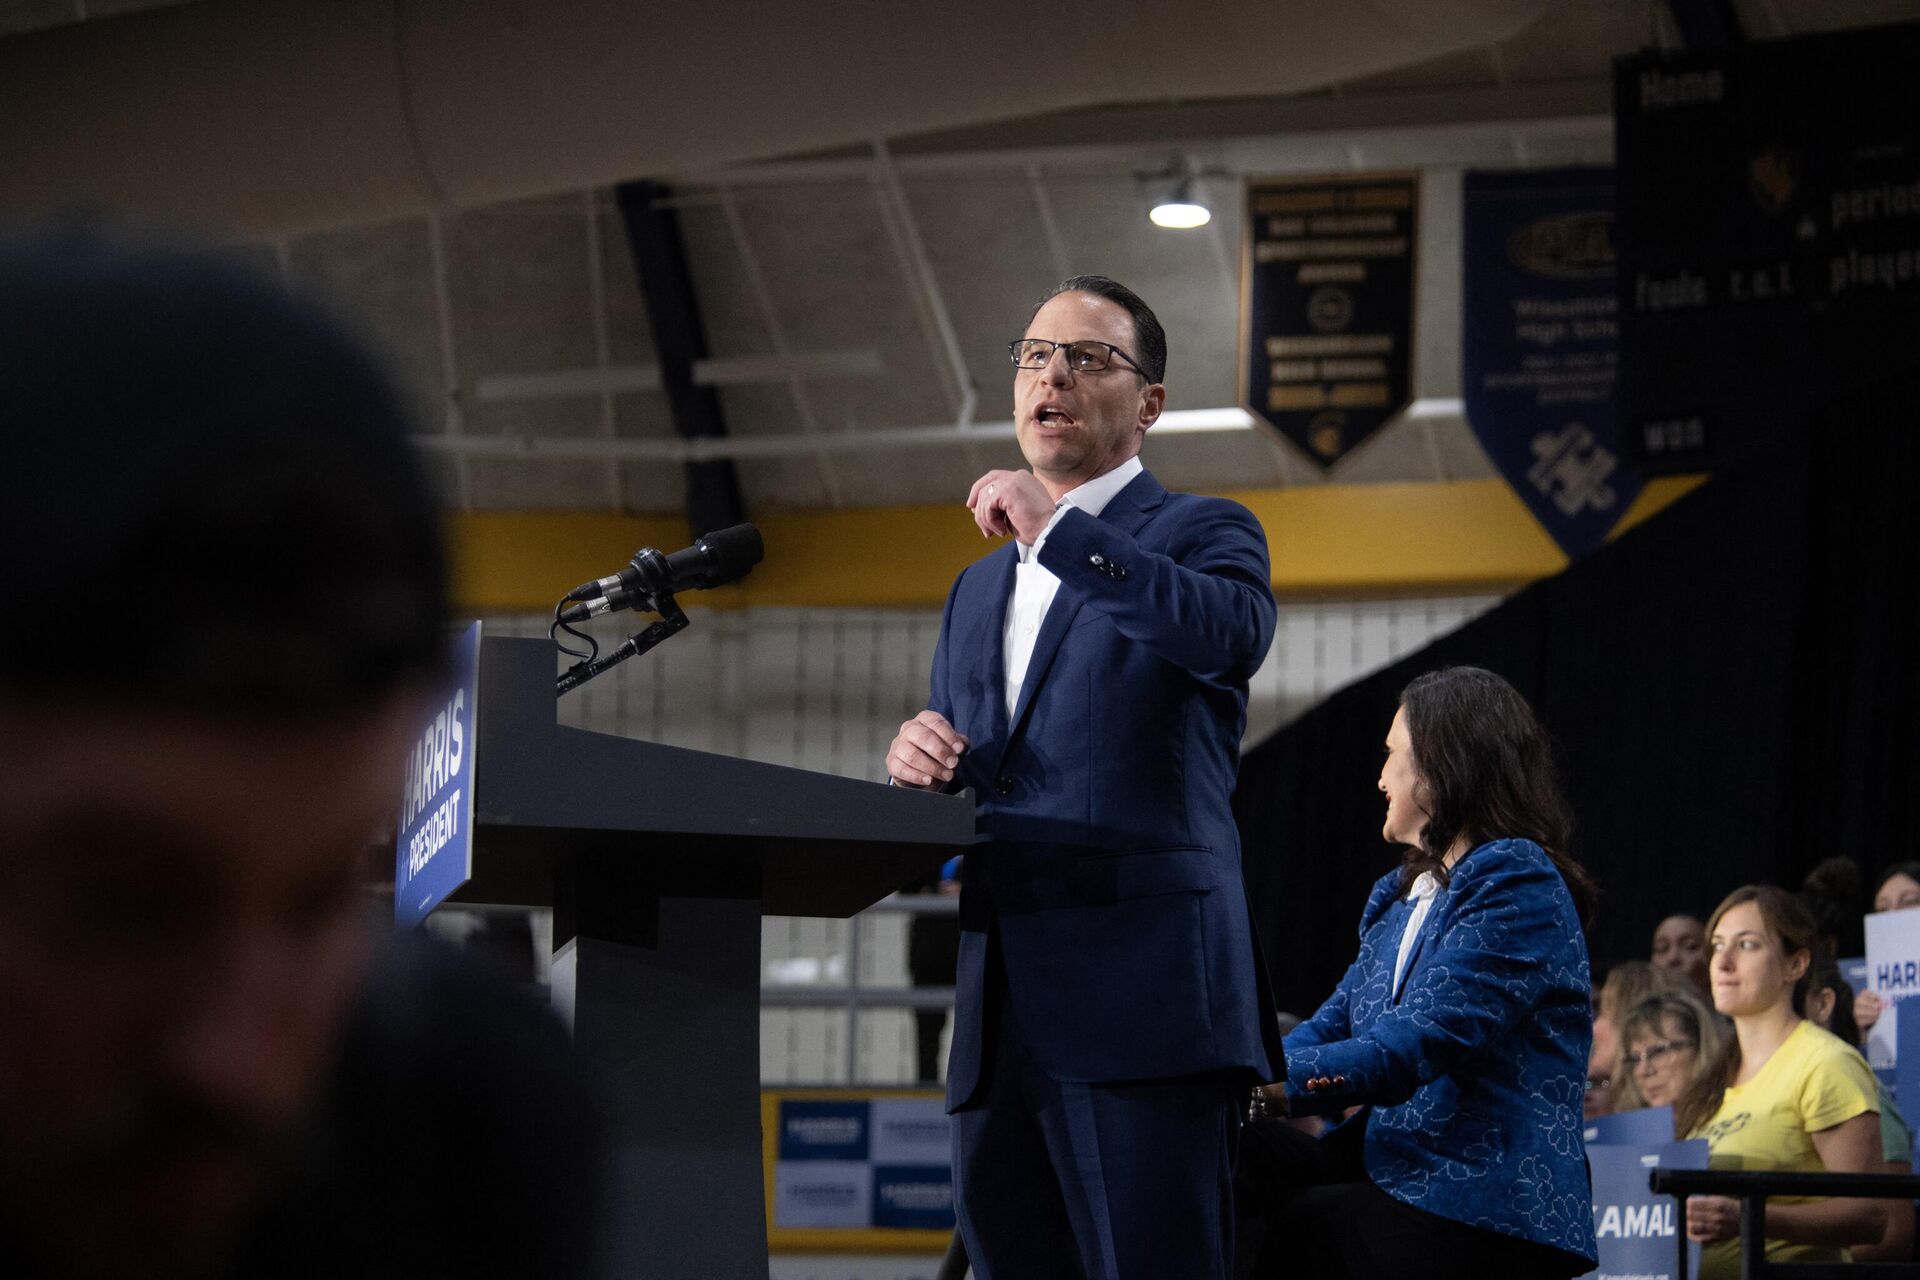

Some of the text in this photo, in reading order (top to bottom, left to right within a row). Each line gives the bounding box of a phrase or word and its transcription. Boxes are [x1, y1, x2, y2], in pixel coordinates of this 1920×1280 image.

[408, 788, 461, 882] PRESIDENT
[1877, 960, 1920, 990] HAR
[1592, 1203, 1676, 1239] AMAL
